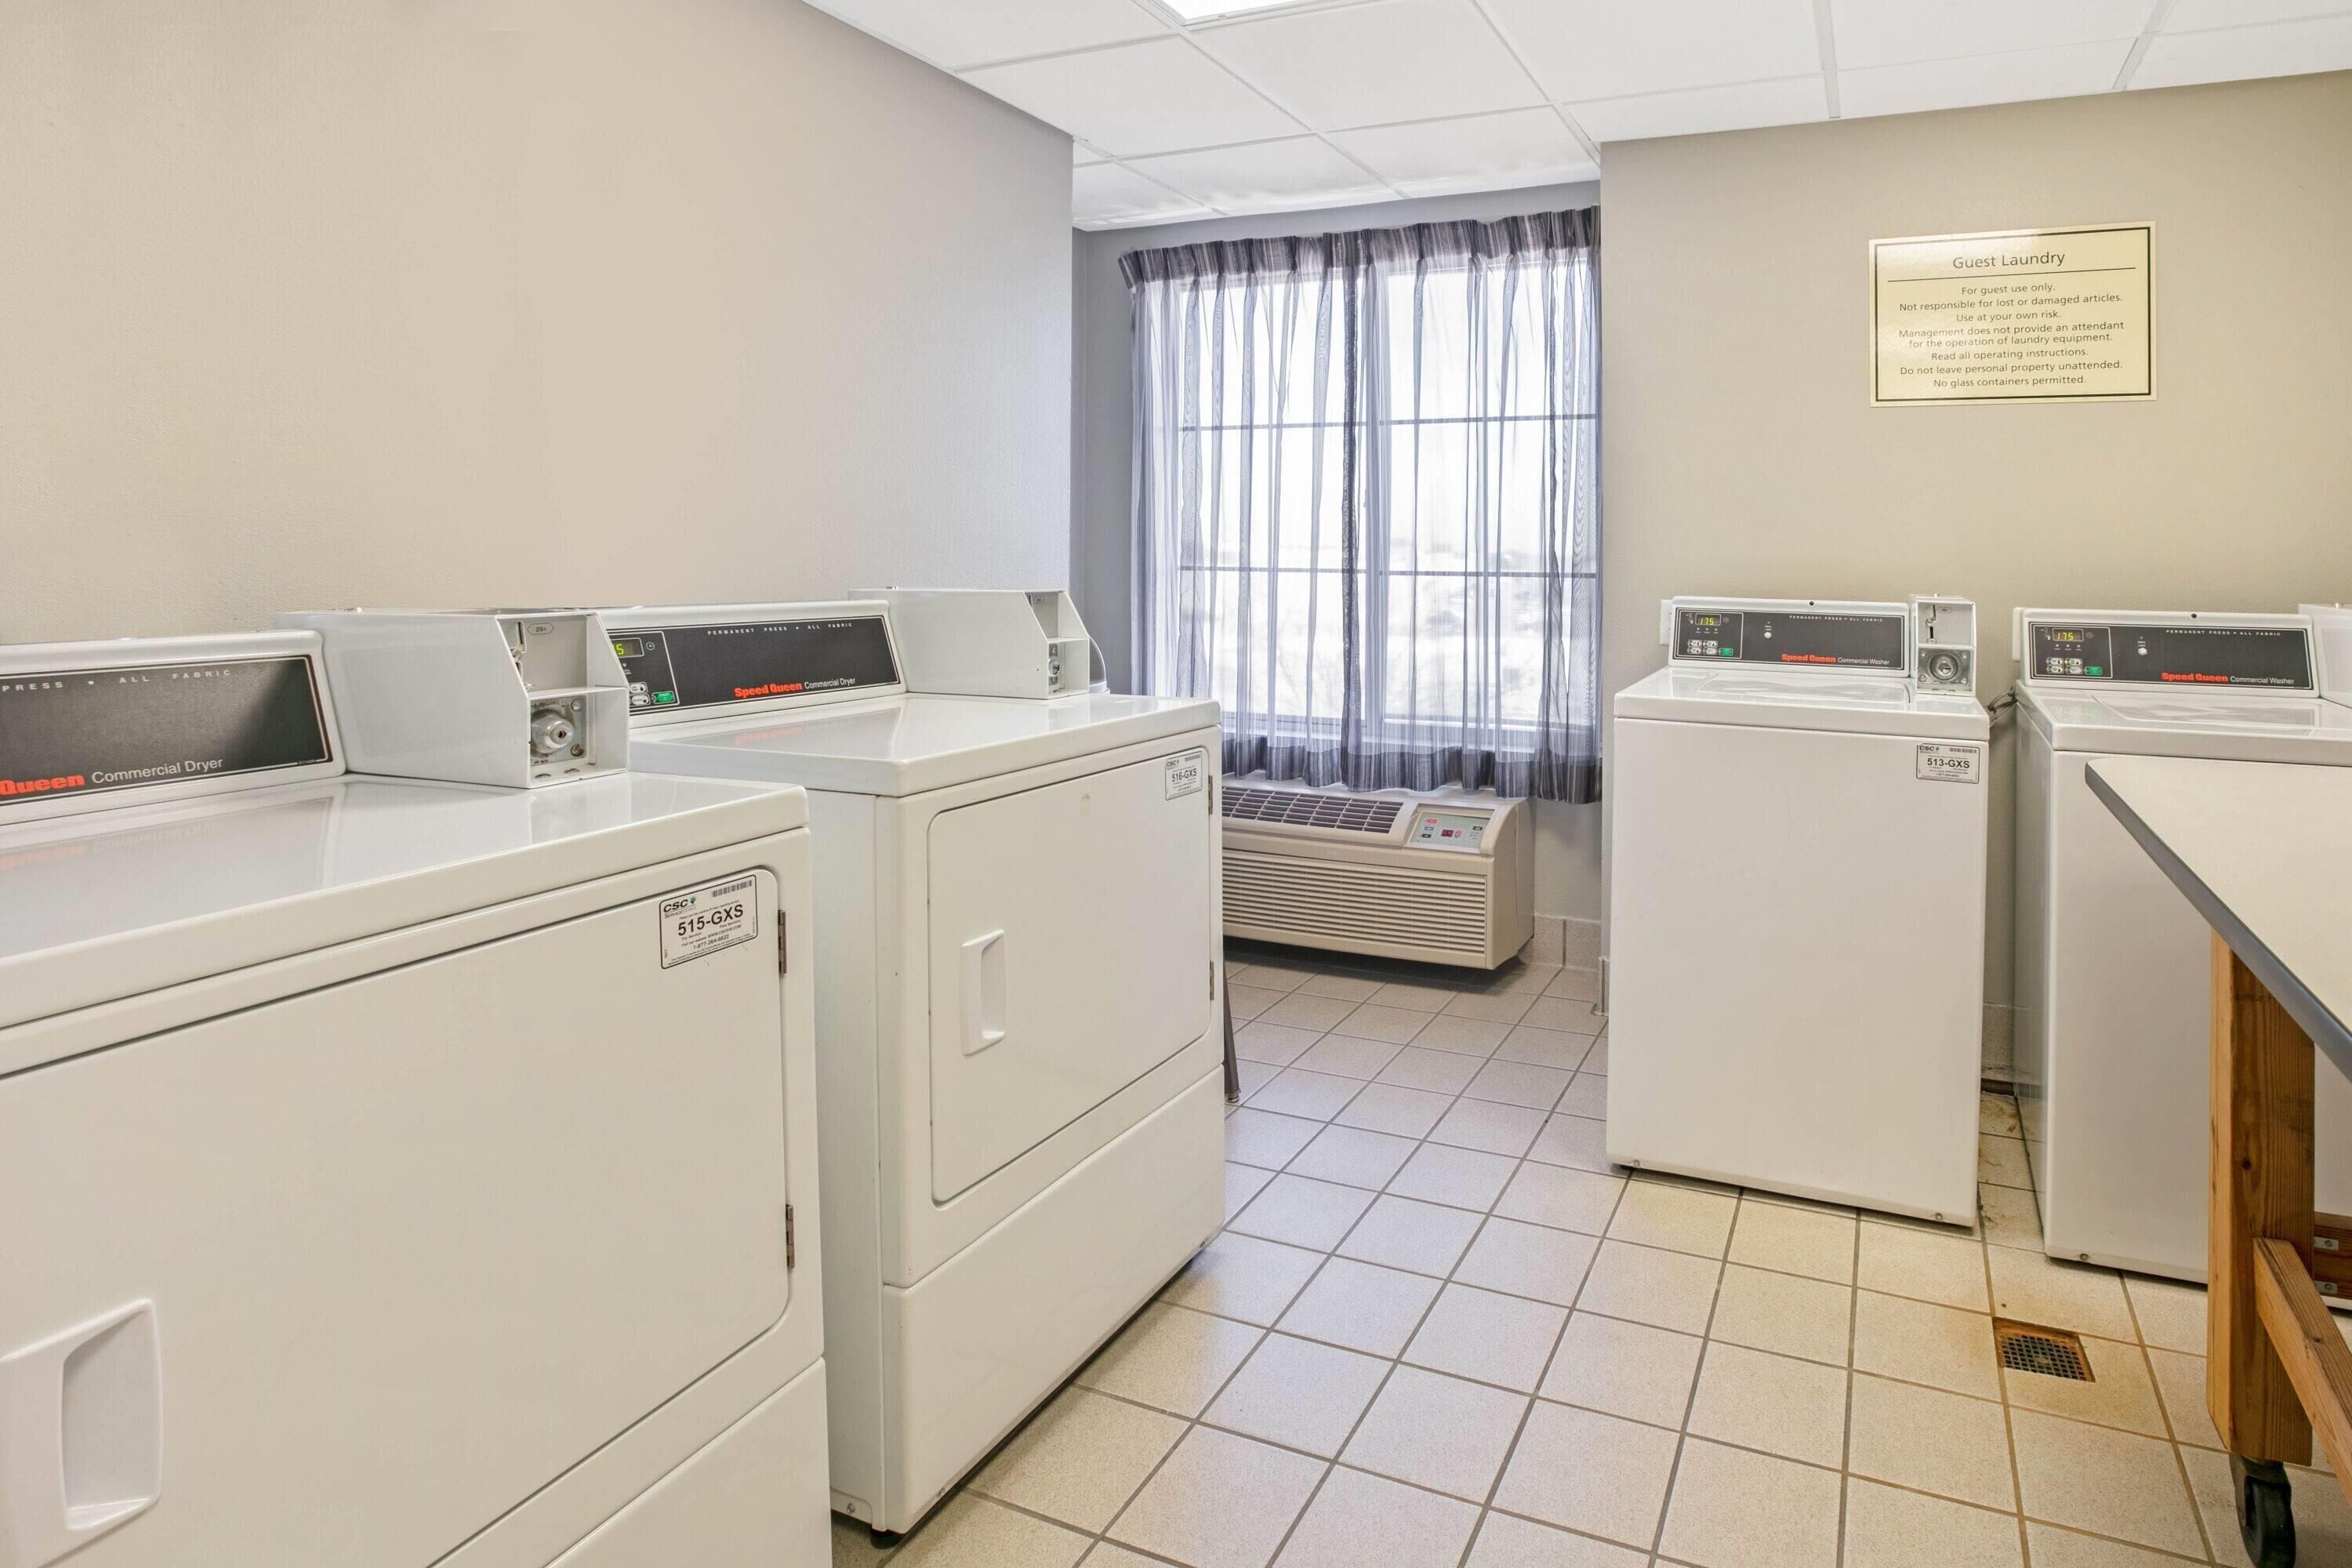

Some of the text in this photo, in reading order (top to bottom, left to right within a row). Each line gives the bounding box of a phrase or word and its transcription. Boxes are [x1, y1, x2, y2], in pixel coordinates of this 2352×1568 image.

[1953, 251, 2065, 269] Guest Laundry
[1980, 285, 2008, 296] guest
[2031, 282, 2056, 292] only.
[1920, 300, 1976, 311] responsible
[2031, 295, 2080, 306] damaged
[2082, 293, 2123, 303] articles.
[1956, 314, 1973, 322] Use
[1990, 314, 2013, 322] your
[2041, 310, 2062, 318] risk.
[1899, 328, 1964, 339] Management
[1967, 326, 1991, 336] does
[2013, 324, 2053, 335] provide
[2071, 321, 2125, 331] attendant
[1909, 333, 2113, 348] for the operation of laundry equipment.
[1973, 350, 2023, 361] operating
[2026, 348, 2089, 358] instructions.
[1936, 365, 1962, 374] leave
[1965, 364, 2008, 374] personal
[2011, 363, 2055, 373] property
[2058, 360, 2123, 370] unattended.
[1951, 378, 1974, 389] glass
[1976, 376, 2029, 387] containers
[2032, 375, 2087, 386] permitted.
[1700, 617, 1715, 626] 175
[2057, 632, 2074, 641] 175
[613, 643, 625, 655] 5
[1781, 654, 1809, 662] Speed
[1809, 655, 1837, 663] Queen
[2, 669, 232, 692] PRESS ALL FABRIC
[2161, 672, 2194, 681] Speed
[2194, 673, 2229, 682] Queen
[2230, 676, 2269, 684] Commercial
[734, 677, 856, 699] Speed Queen Commercial Dryer
[1927, 757, 1970, 769] 513-GXS
[0, 757, 223, 795] Queen Commercial Dryer
[1171, 768, 1197, 782] 516-GXS
[663, 899, 688, 913] CSC
[677, 904, 744, 936] 515-GXS
